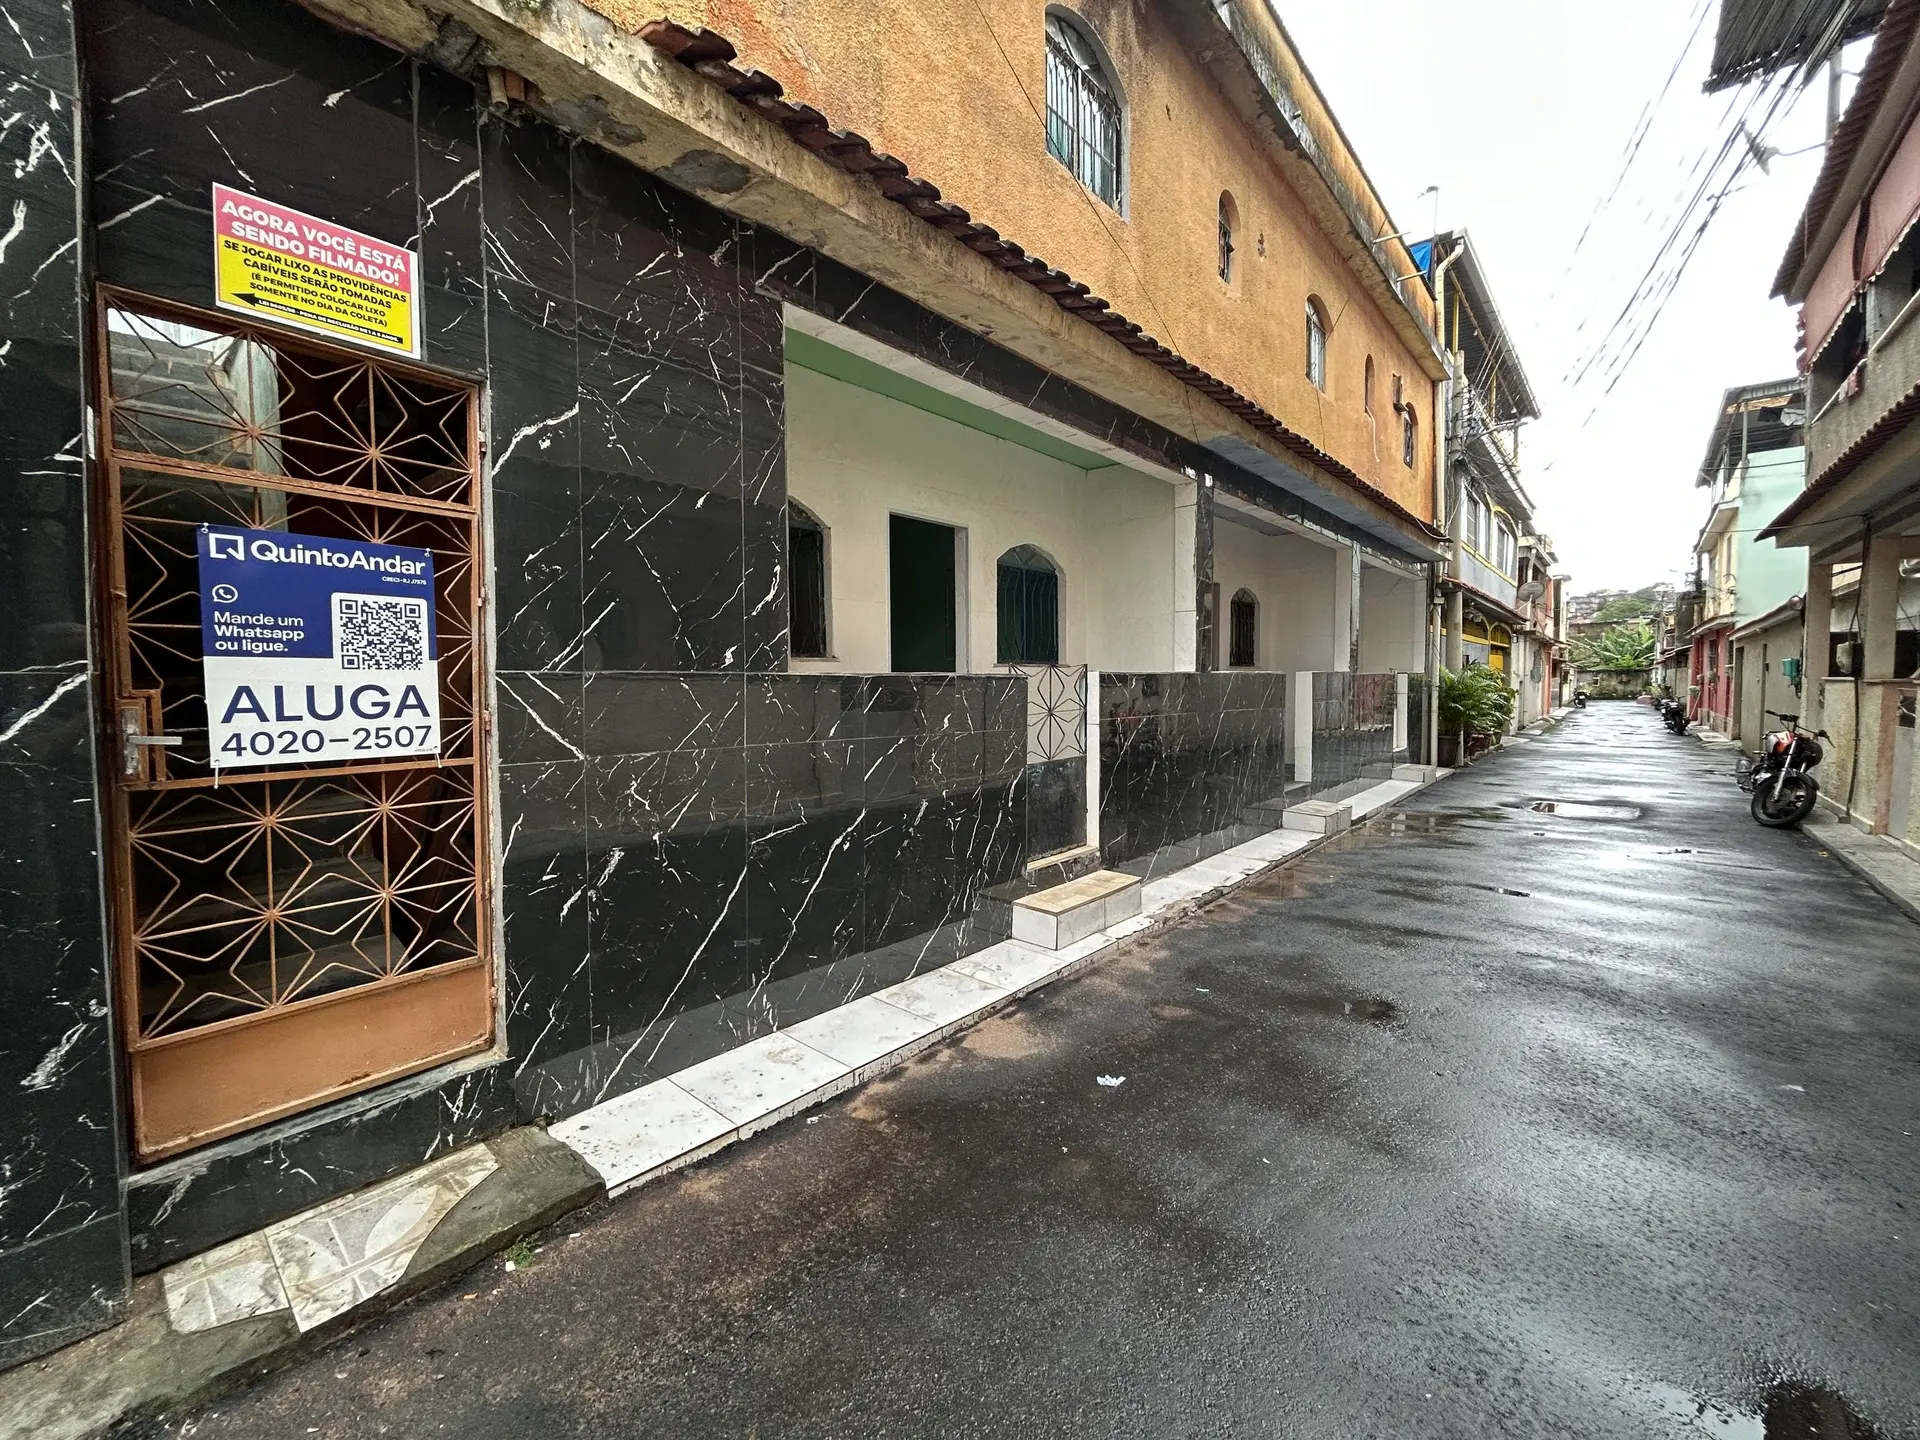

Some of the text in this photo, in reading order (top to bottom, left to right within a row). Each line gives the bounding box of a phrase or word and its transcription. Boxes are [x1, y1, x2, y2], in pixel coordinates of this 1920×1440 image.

[221, 199, 406, 272] AGORA VOCÊ ESTÁ
[231, 221, 399, 286] SENDO FILMADO!
[224, 240, 406, 303] SE JOGAR LIXO AS PROVIDÊNCIAS
[243, 258, 392, 309] CABÍVEIS SERÃO TOMADAS
[250, 282, 387, 327] SOMENTE NO DIA DA COLETA)
[251, 272, 386, 317] (É PERMITIDO COLOCAR LIXO
[250, 539, 426, 575] QuintoAndar
[213, 611, 304, 627] Mande um
[213, 625, 305, 642] Whatsapp
[215, 639, 289, 654] ou ligue.
[220, 684, 431, 724] ALUGA
[220, 725, 432, 757] 4020-2507
